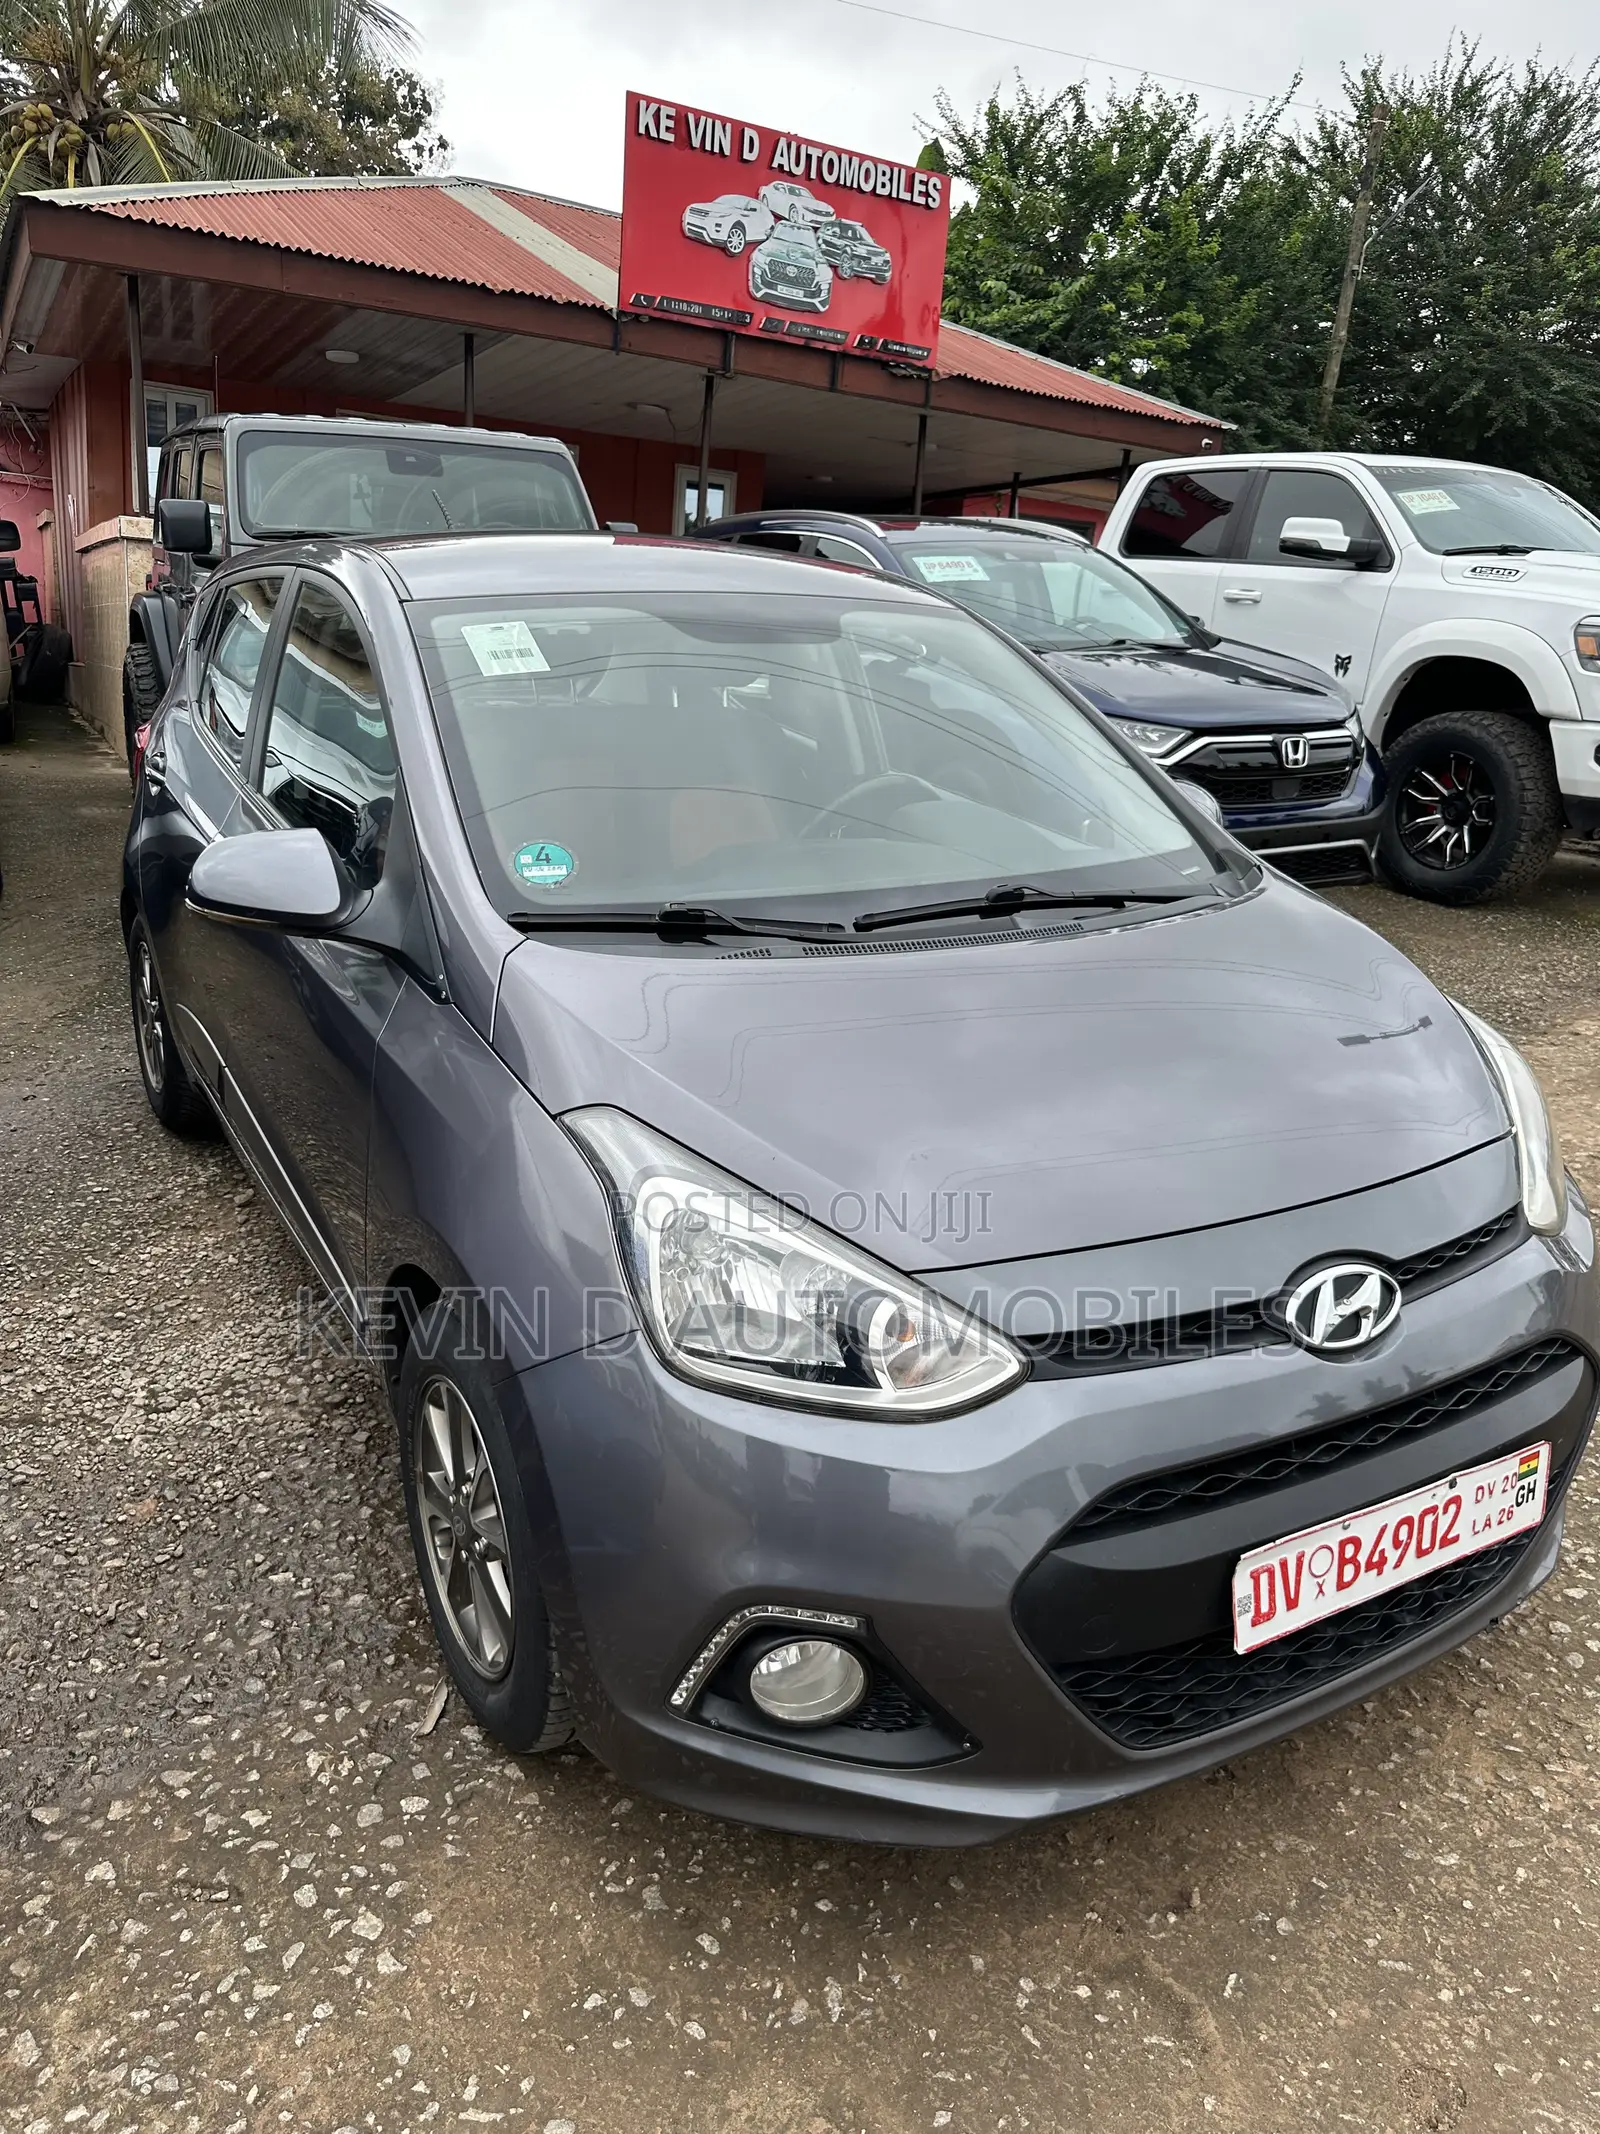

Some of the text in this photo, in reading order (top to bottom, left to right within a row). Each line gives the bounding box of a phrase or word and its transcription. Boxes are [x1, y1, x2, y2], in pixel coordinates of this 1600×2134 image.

[638, 100, 942, 209] KE VIN D AUTOMOBILES
[1475, 567, 1517, 576] 1500
[535, 846, 552, 864] 4
[1474, 1471, 1518, 1505] DV 20
[1514, 1479, 1538, 1508] GH
[1472, 1504, 1515, 1537] LA 26
[1250, 1550, 1305, 1628] DV
[1336, 1494, 1463, 1593] B4902
